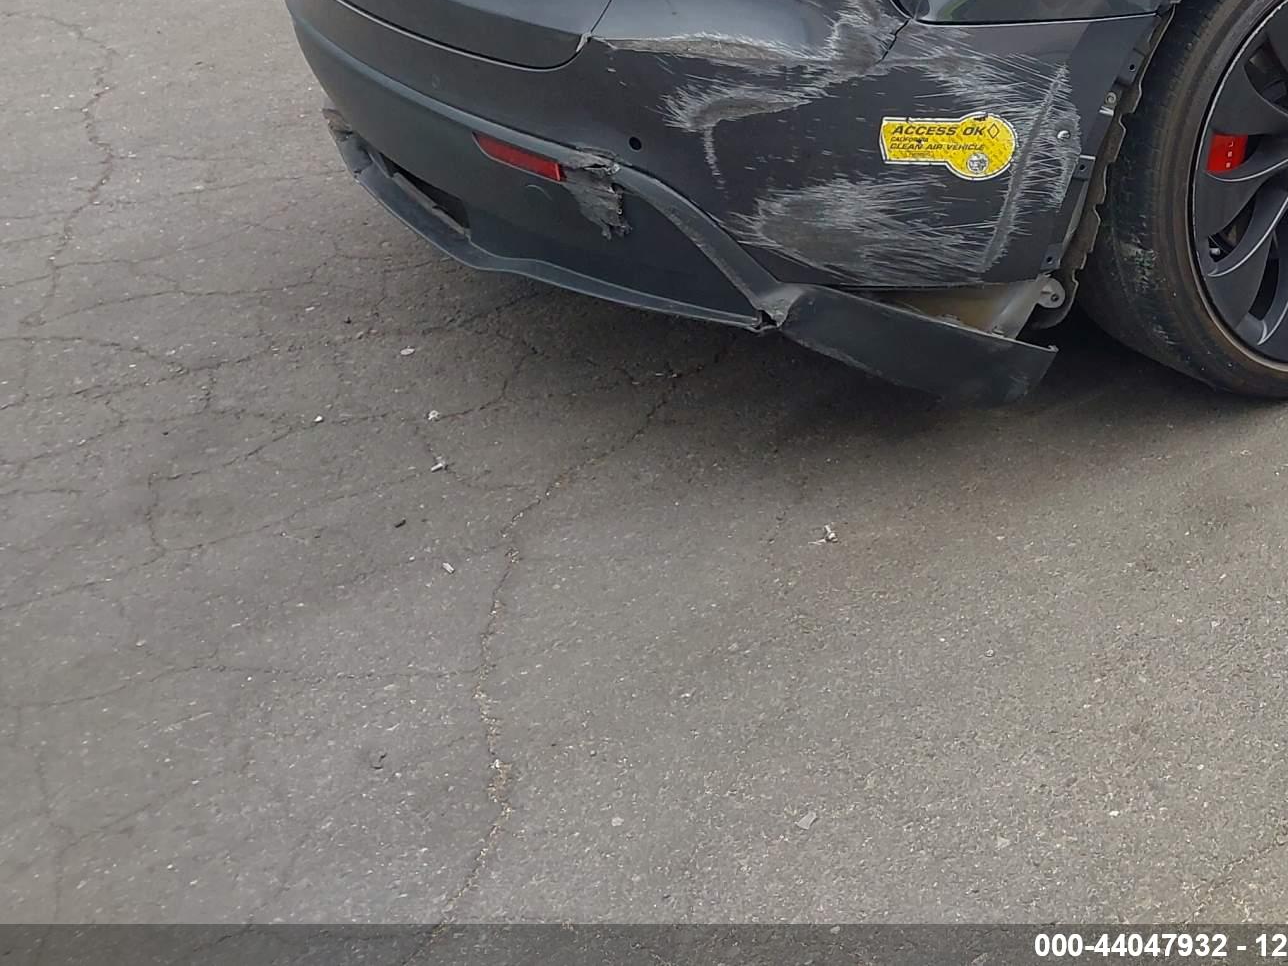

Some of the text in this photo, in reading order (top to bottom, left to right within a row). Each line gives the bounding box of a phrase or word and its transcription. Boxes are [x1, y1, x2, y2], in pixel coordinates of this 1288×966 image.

[892, 125, 985, 136] ACCESS OK
[890, 142, 922, 150] CLEAN
[946, 143, 985, 151] VEHICLE
